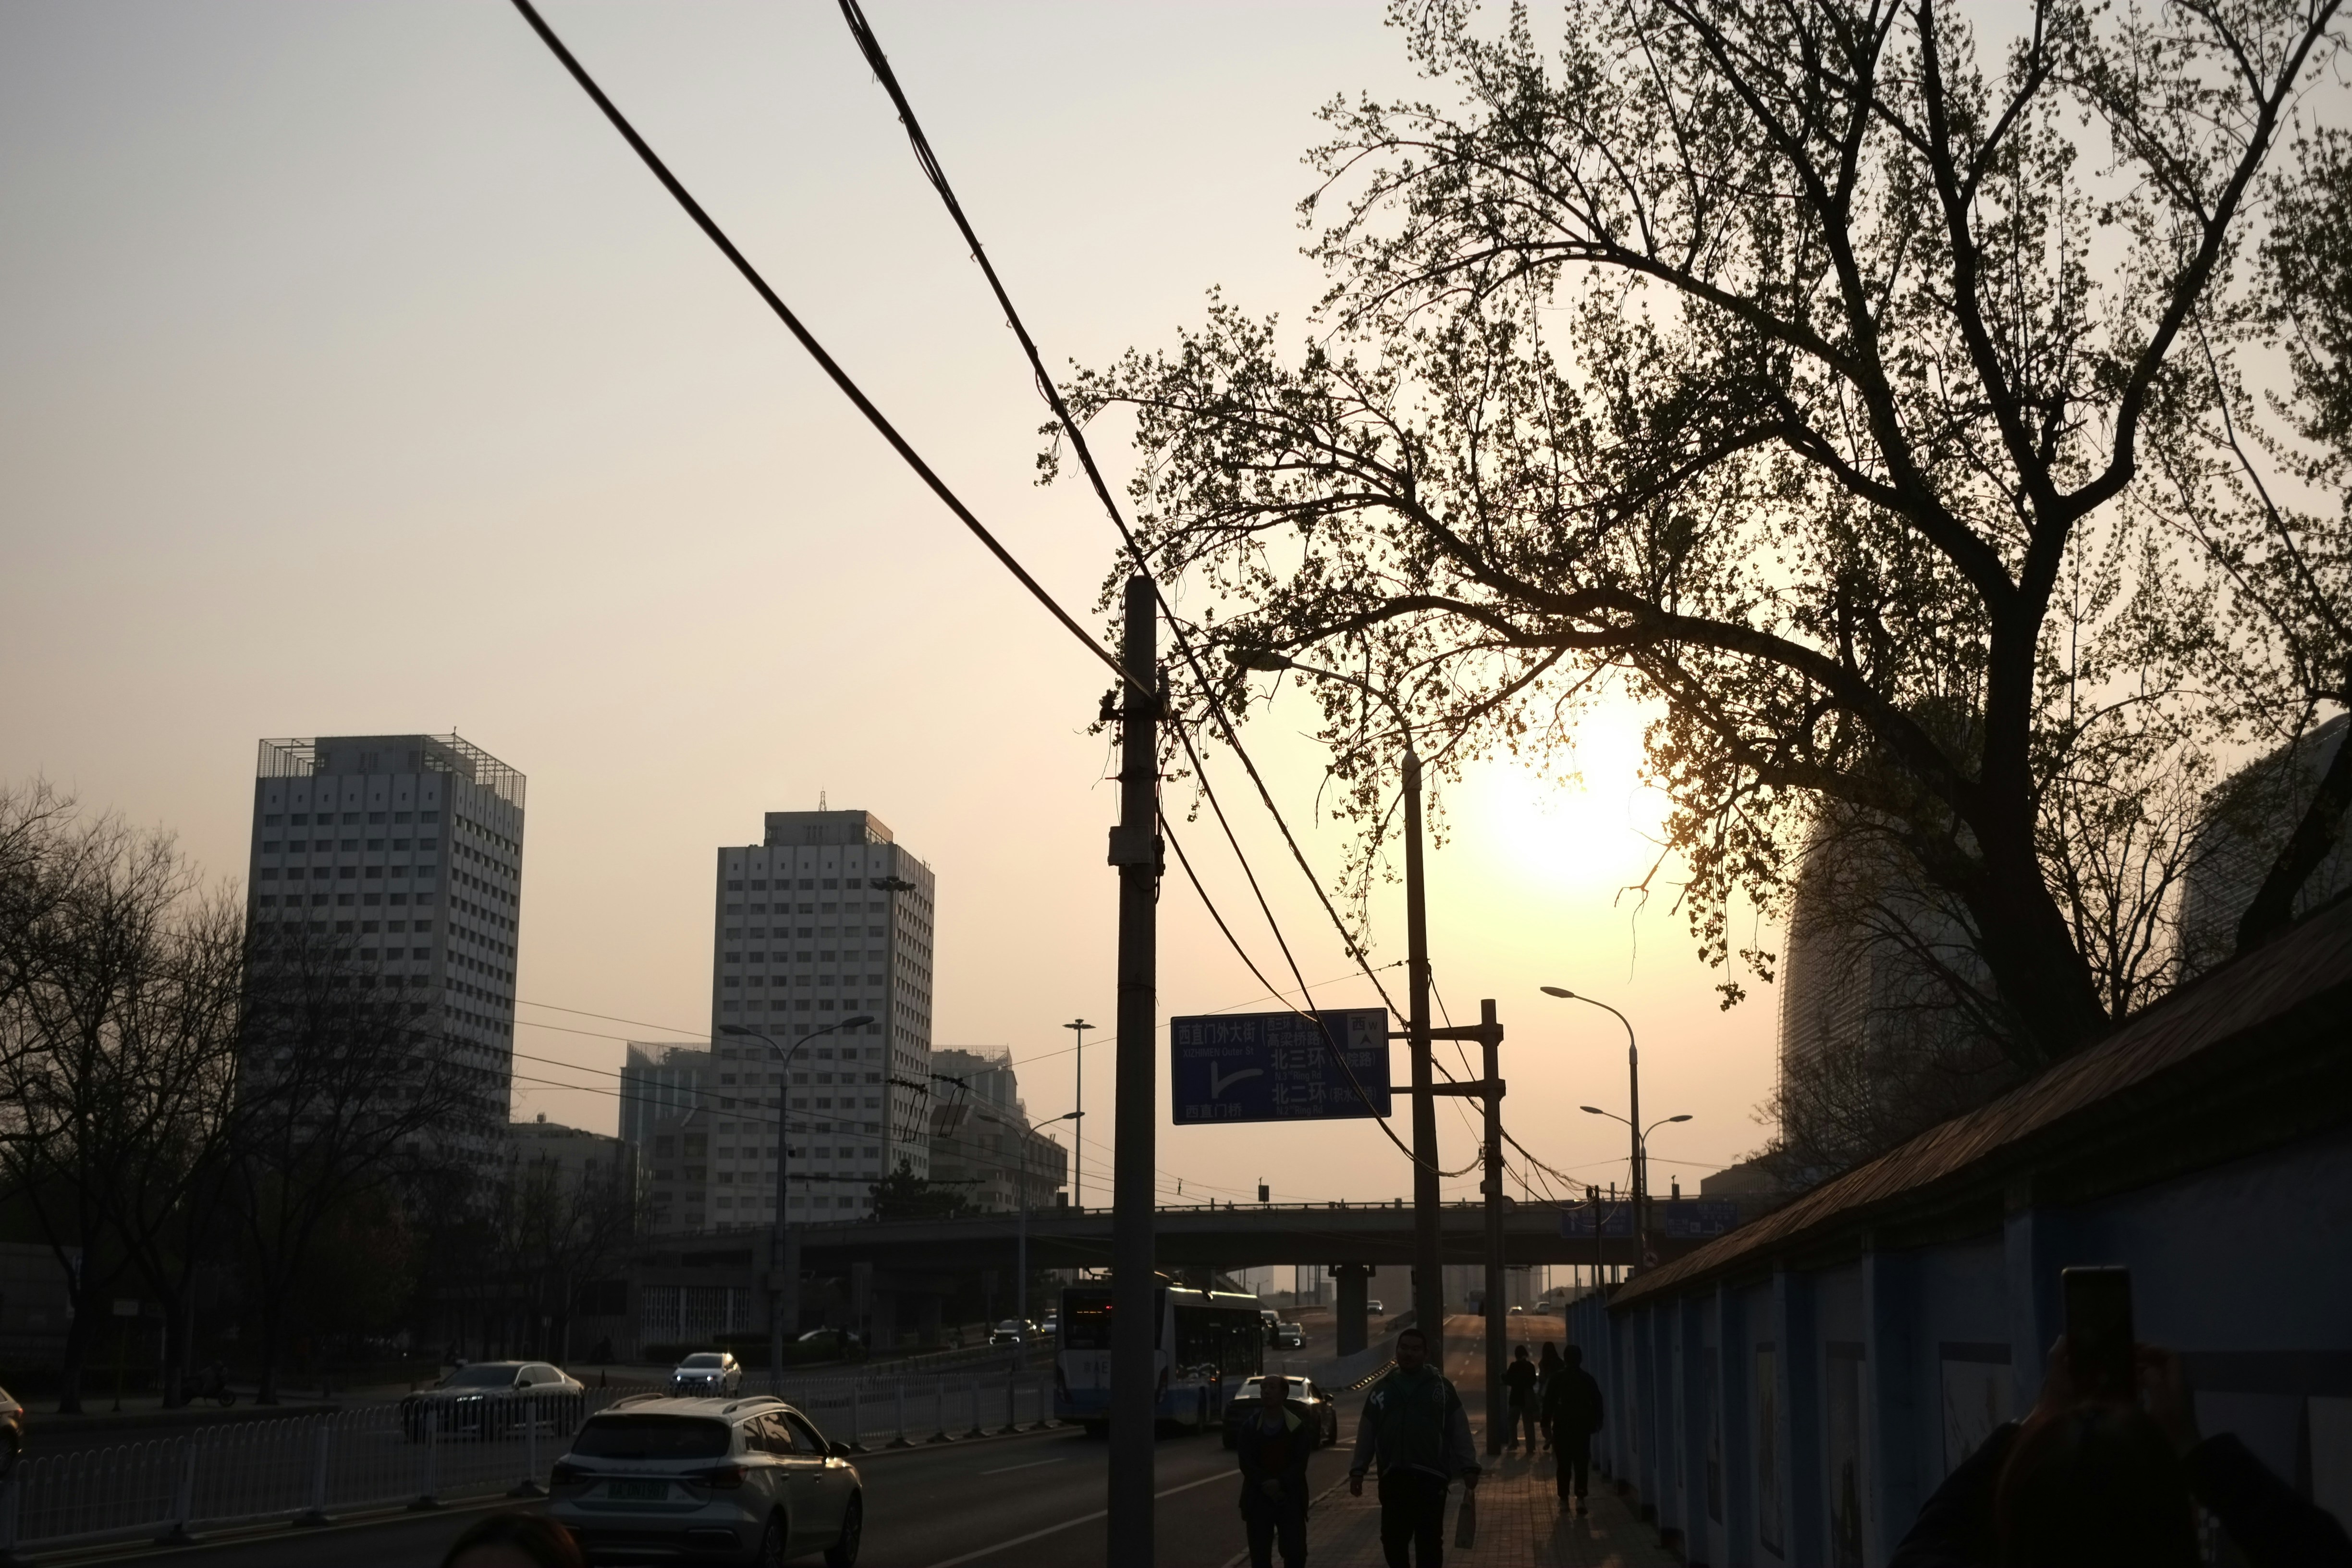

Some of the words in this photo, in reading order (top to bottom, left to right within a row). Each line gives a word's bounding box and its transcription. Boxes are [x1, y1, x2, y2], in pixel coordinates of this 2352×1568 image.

[1351, 1017, 1366, 1031] 西
[1368, 1022, 1378, 1030] W
[1178, 1022, 1256, 1046] 西直门外大街
[1183, 1048, 1220, 1058] XIZHIMEN
[1222, 1047, 1242, 1056] Outer
[1245, 1046, 1254, 1055] St
[1271, 1047, 1326, 1070] 北三环
[1312, 1070, 1322, 1079] Rd
[1272, 1082, 1327, 1105] 北二环
[1186, 1102, 1242, 1118] 西直门桥
[1313, 1105, 1323, 1115] Rd
